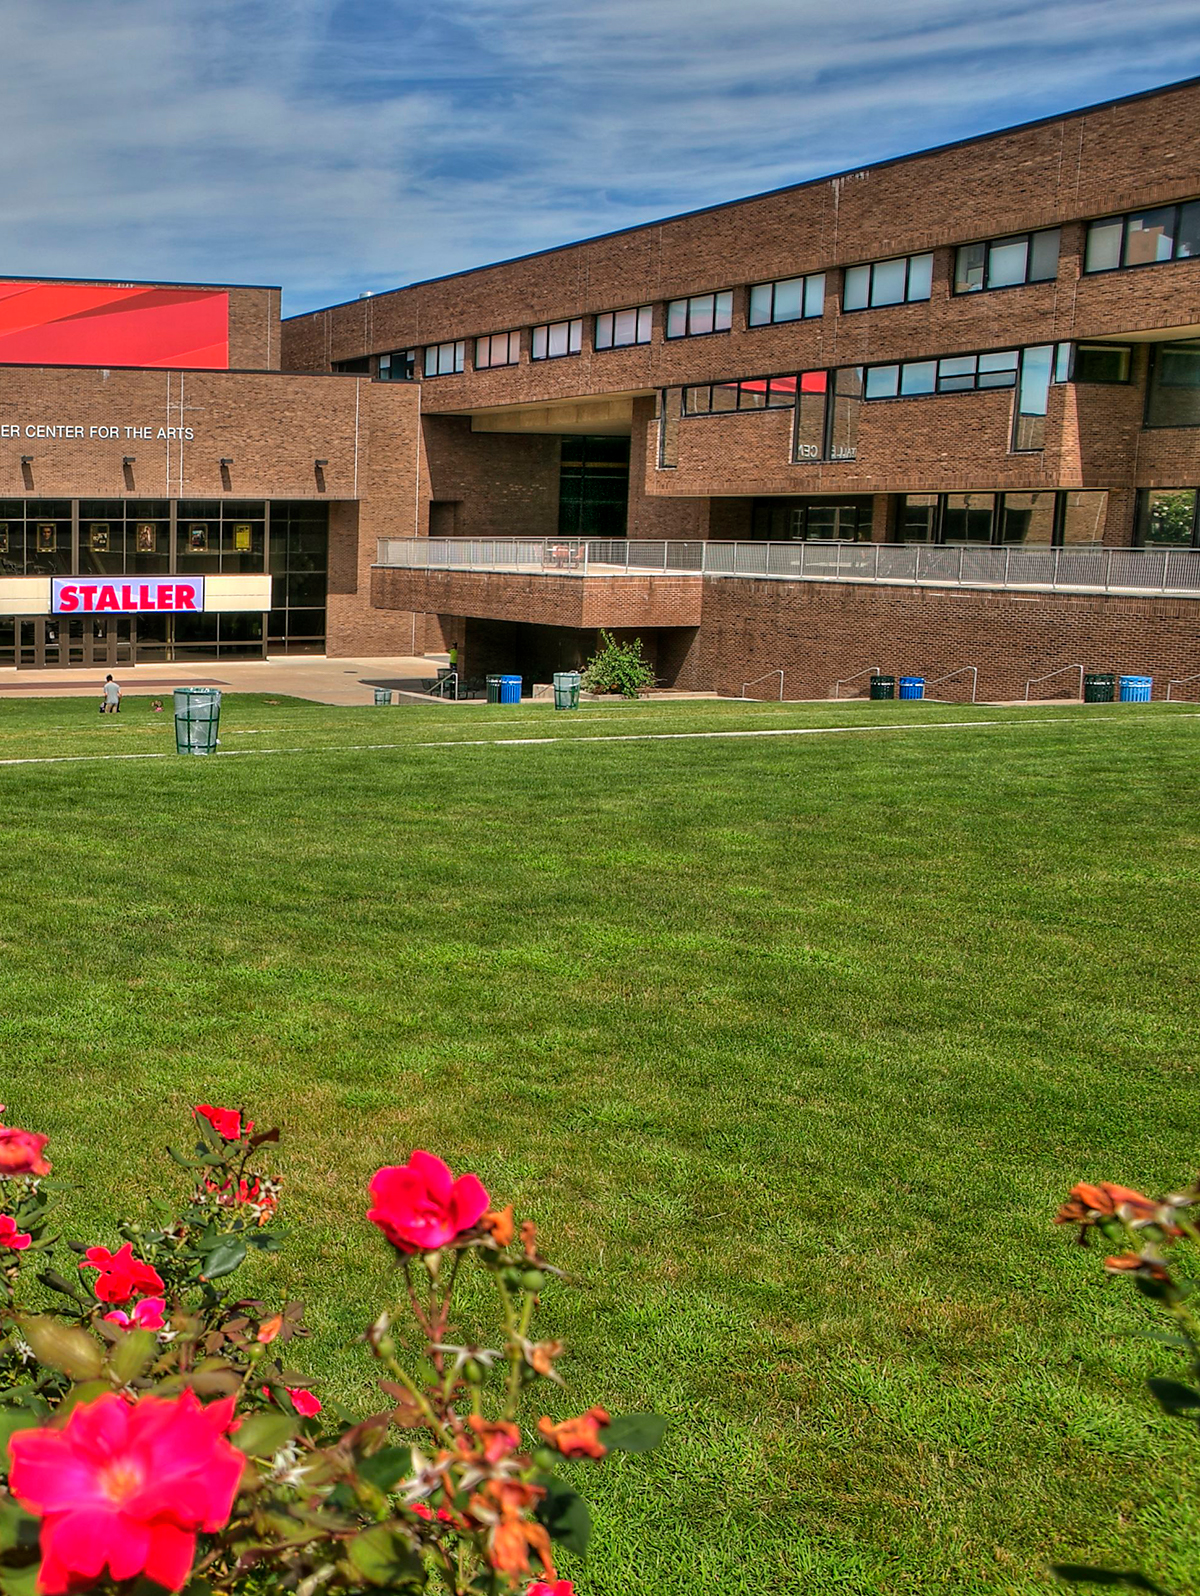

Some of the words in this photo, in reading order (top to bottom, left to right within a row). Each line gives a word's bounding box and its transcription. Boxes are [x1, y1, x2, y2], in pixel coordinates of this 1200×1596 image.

[25, 425, 85, 439] CENTER
[89, 426, 119, 439] FOR
[124, 427, 152, 440] THE
[156, 427, 194, 440] ARTS
[59, 584, 196, 611] STALLER
